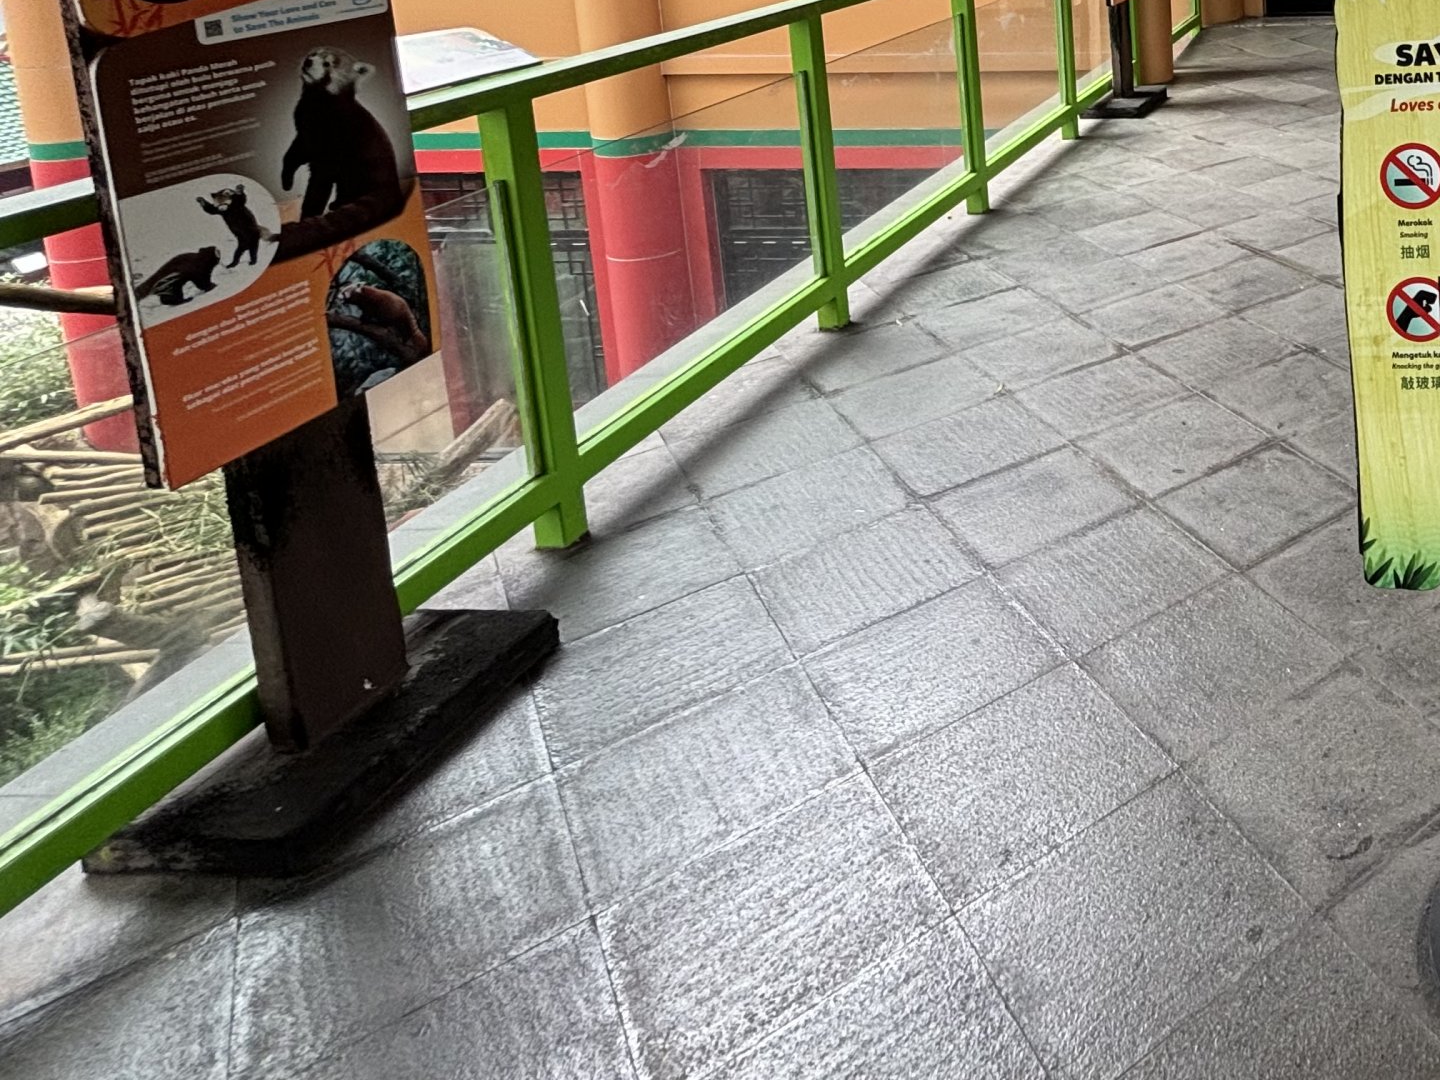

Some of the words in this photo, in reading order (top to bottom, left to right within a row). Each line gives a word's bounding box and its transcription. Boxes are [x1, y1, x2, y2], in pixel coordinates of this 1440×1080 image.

[1374, 71, 1434, 85] DENGAN
[1390, 98, 1434, 113] Loves
[1397, 218, 1433, 227] Merokok
[1399, 231, 1429, 240] Smoking
[1400, 244, 1431, 260] 抽烟
[1391, 351, 1432, 361] Mengetuk
